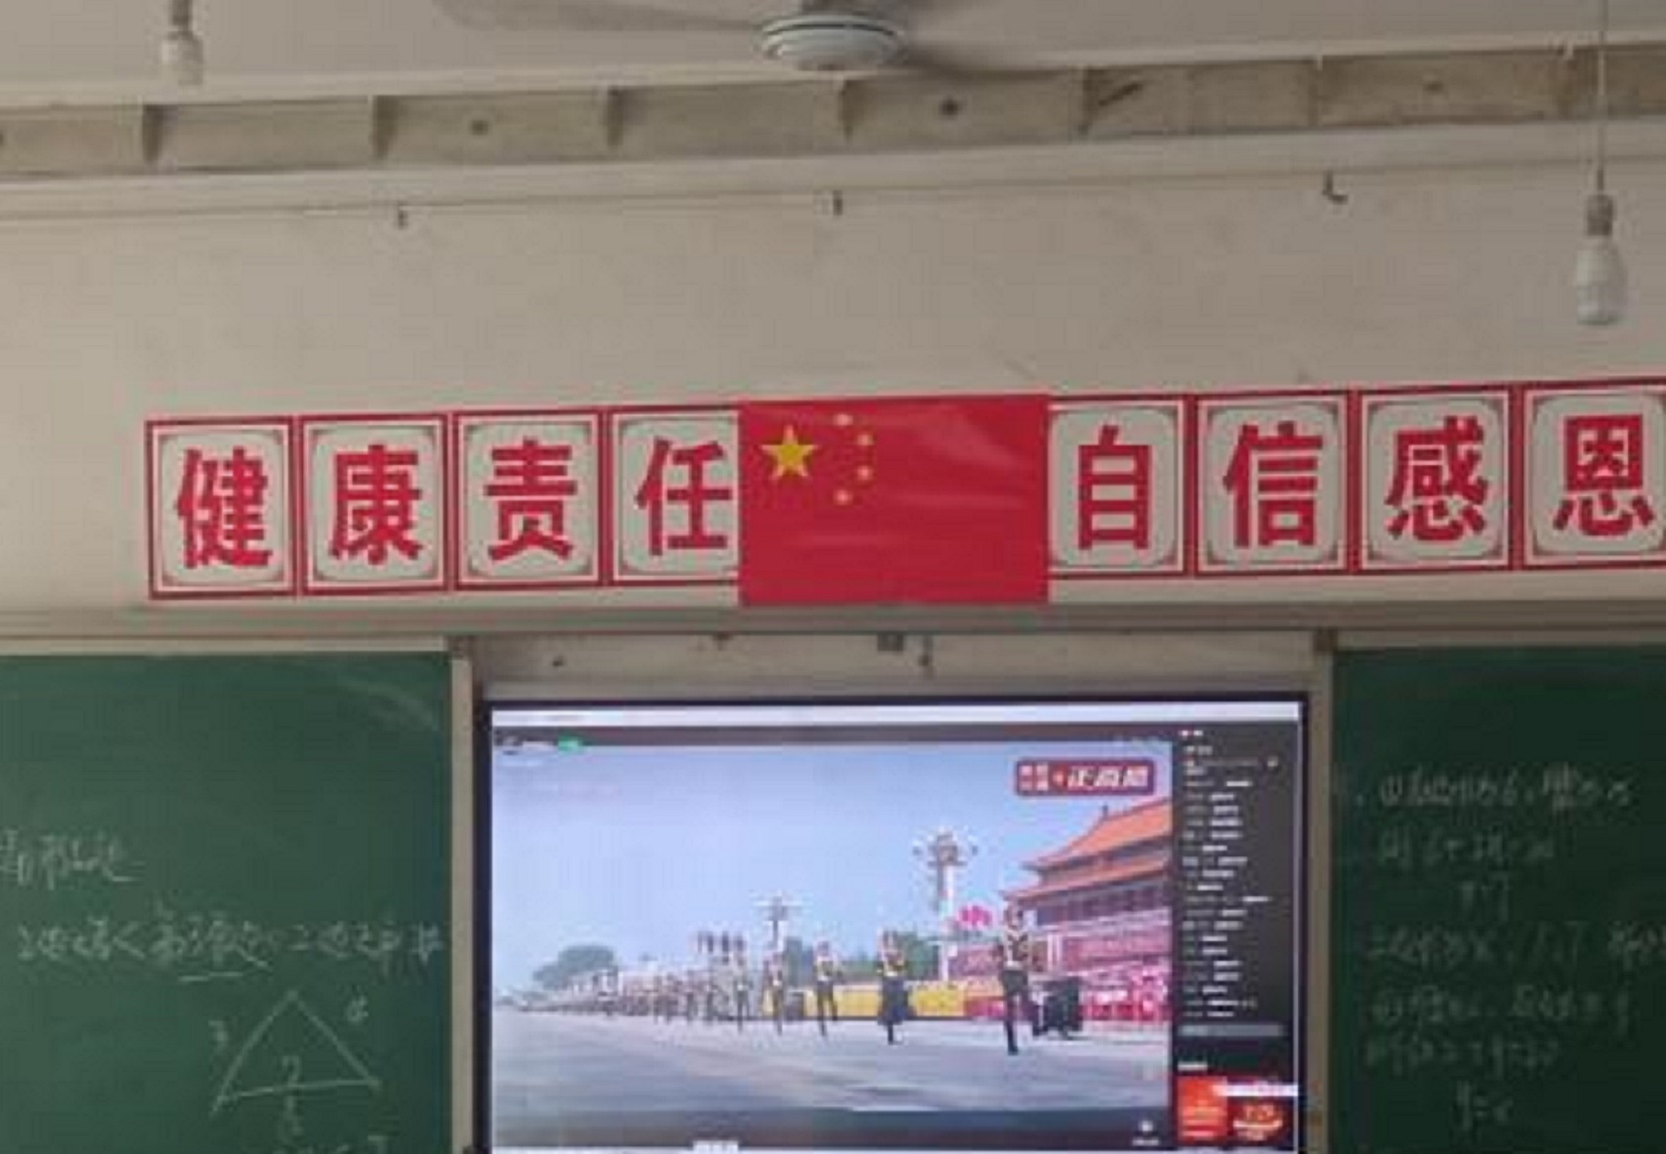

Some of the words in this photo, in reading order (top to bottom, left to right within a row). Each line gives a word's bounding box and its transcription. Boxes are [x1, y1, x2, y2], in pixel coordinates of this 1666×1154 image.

[173, 434, 733, 569] 健康责任
[1076, 413, 1655, 549] 自信感恩
